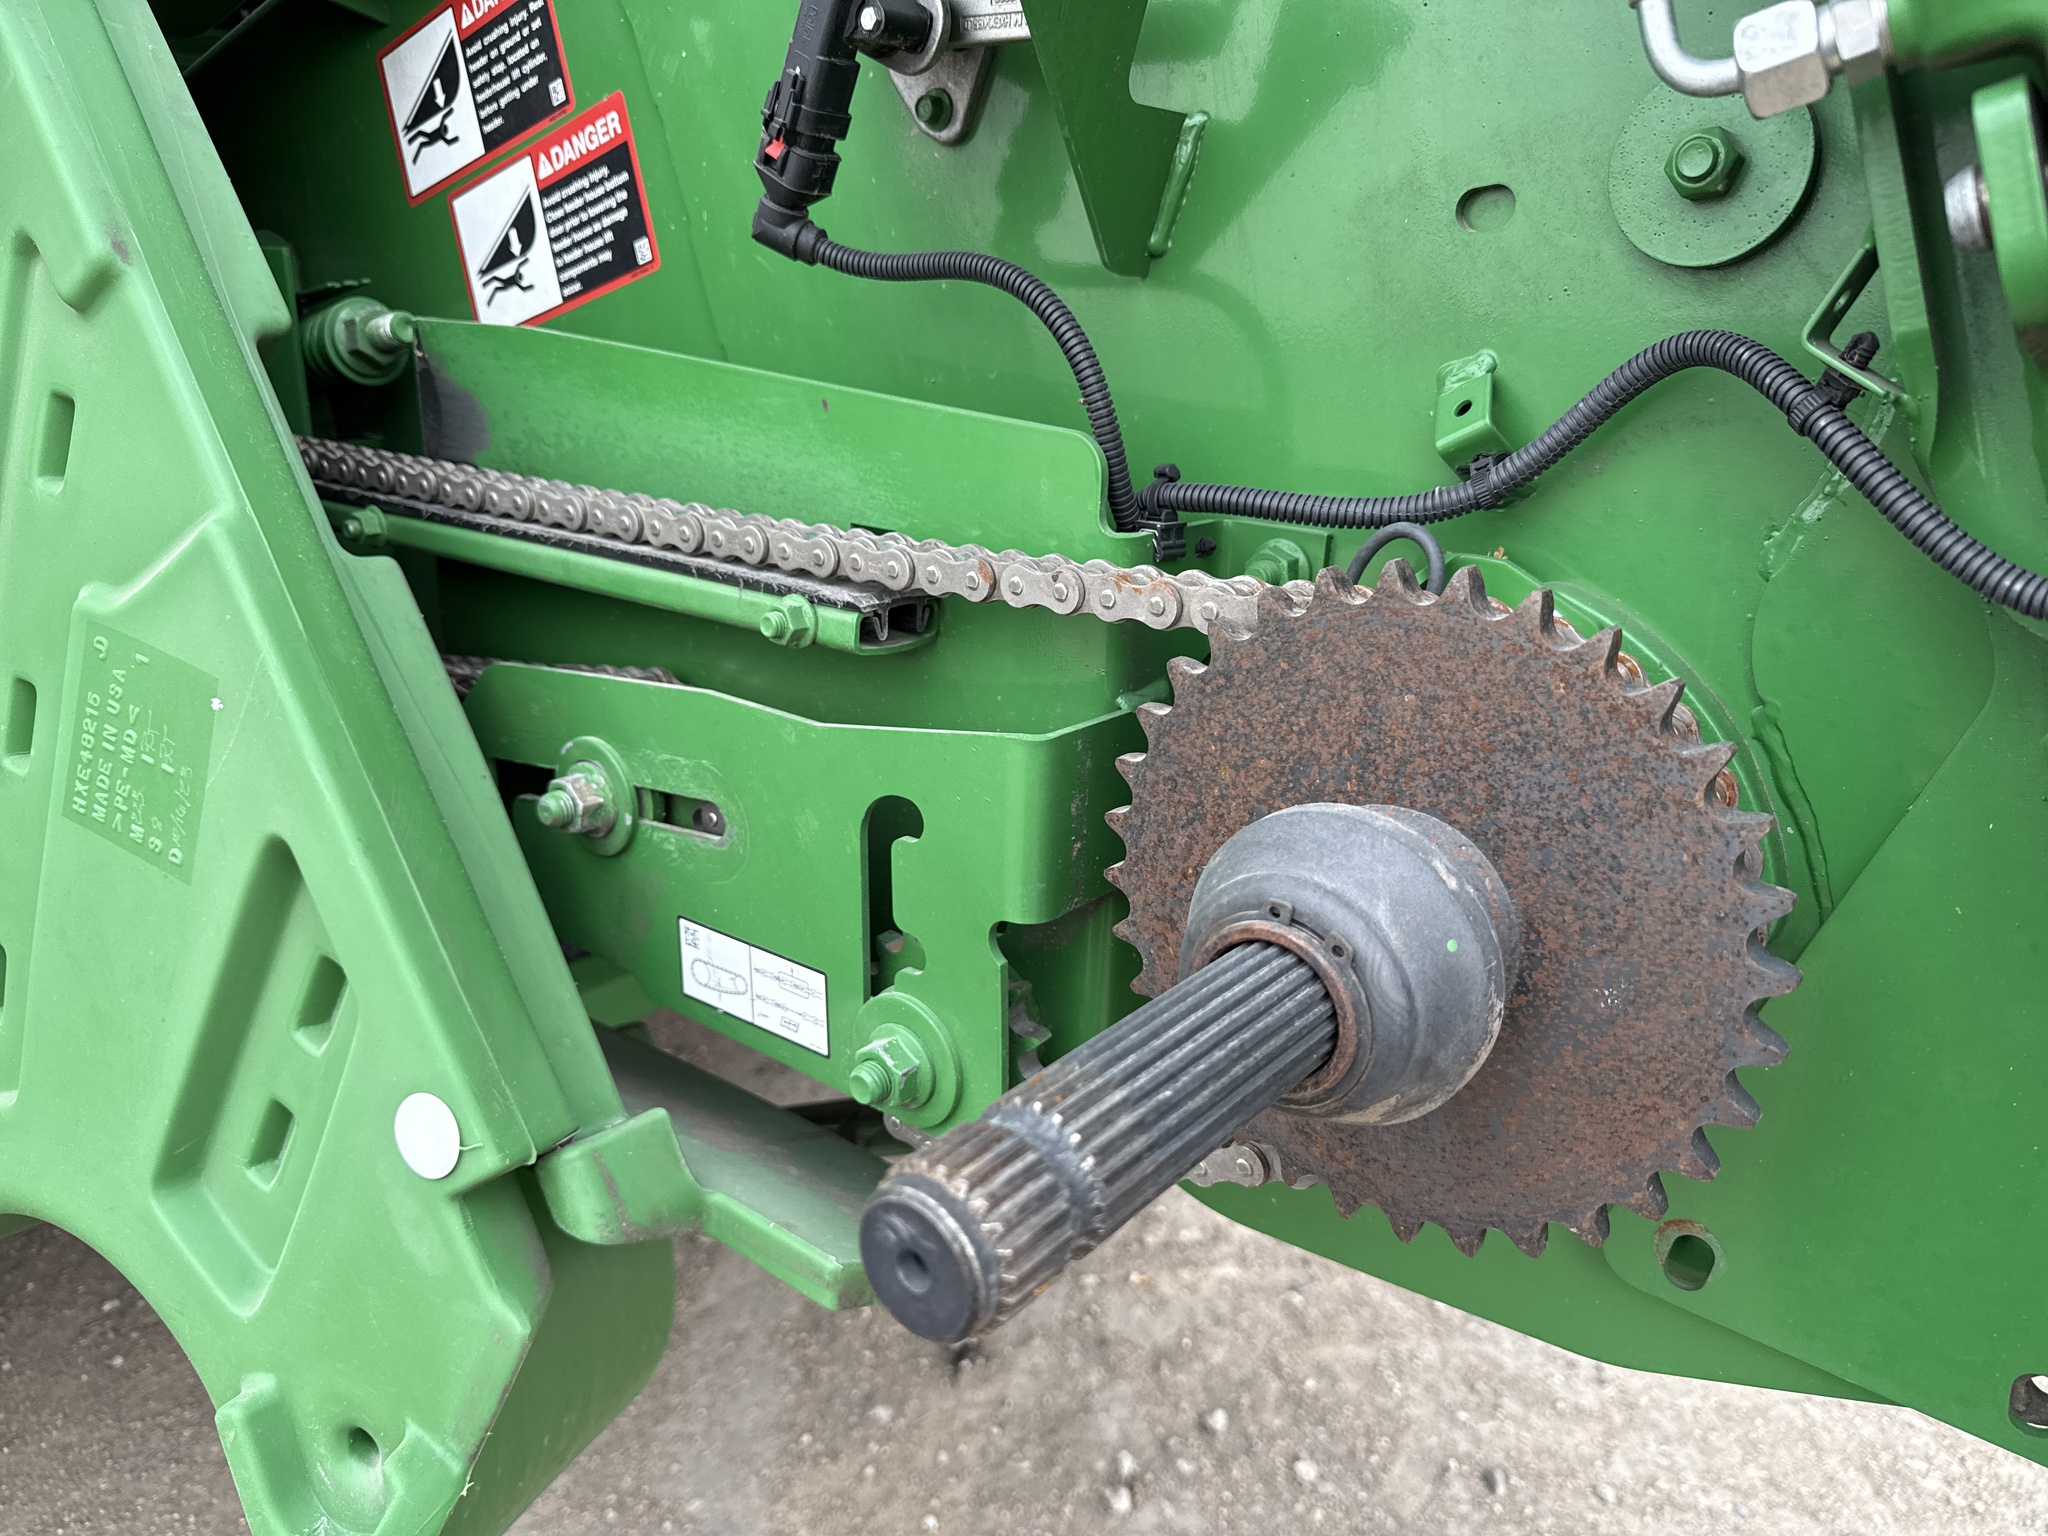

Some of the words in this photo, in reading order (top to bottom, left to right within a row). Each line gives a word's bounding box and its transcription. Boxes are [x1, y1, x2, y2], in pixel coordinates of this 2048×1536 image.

[465, 38, 483, 58] Avoid
[483, 22, 510, 45] crushing
[509, 8, 529, 27] injury.
[528, 0, 545, 13] Rest
[489, 48, 499, 59] on
[499, 30, 522, 54] ground
[521, 26, 530, 37] or
[530, 16, 542, 31] set
[472, 70, 490, 89] safety
[506, 42, 530, 65] located
[530, 37, 541, 50] on
[511, 66, 521, 81] lift
[478, 101, 499, 119] before
[498, 86, 521, 109] getting
[520, 74, 539, 93] under
[549, 109, 623, 172] DANGER
[542, 186, 562, 209] Avoid
[561, 173, 590, 199] crushing
[583, 183, 606, 203] house
[605, 169, 630, 192] bottom
[587, 192, 617, 219] lowering
[615, 187, 629, 204] the
[571, 222, 594, 243] house
[601, 205, 629, 228] damage
[583, 234, 605, 253] house
[558, 254, 599, 283] components
[106, 669, 127, 716] USA
[72, 691, 101, 814] HXE48215
[102, 723, 119, 751] IN
[91, 758, 114, 823] MADE
